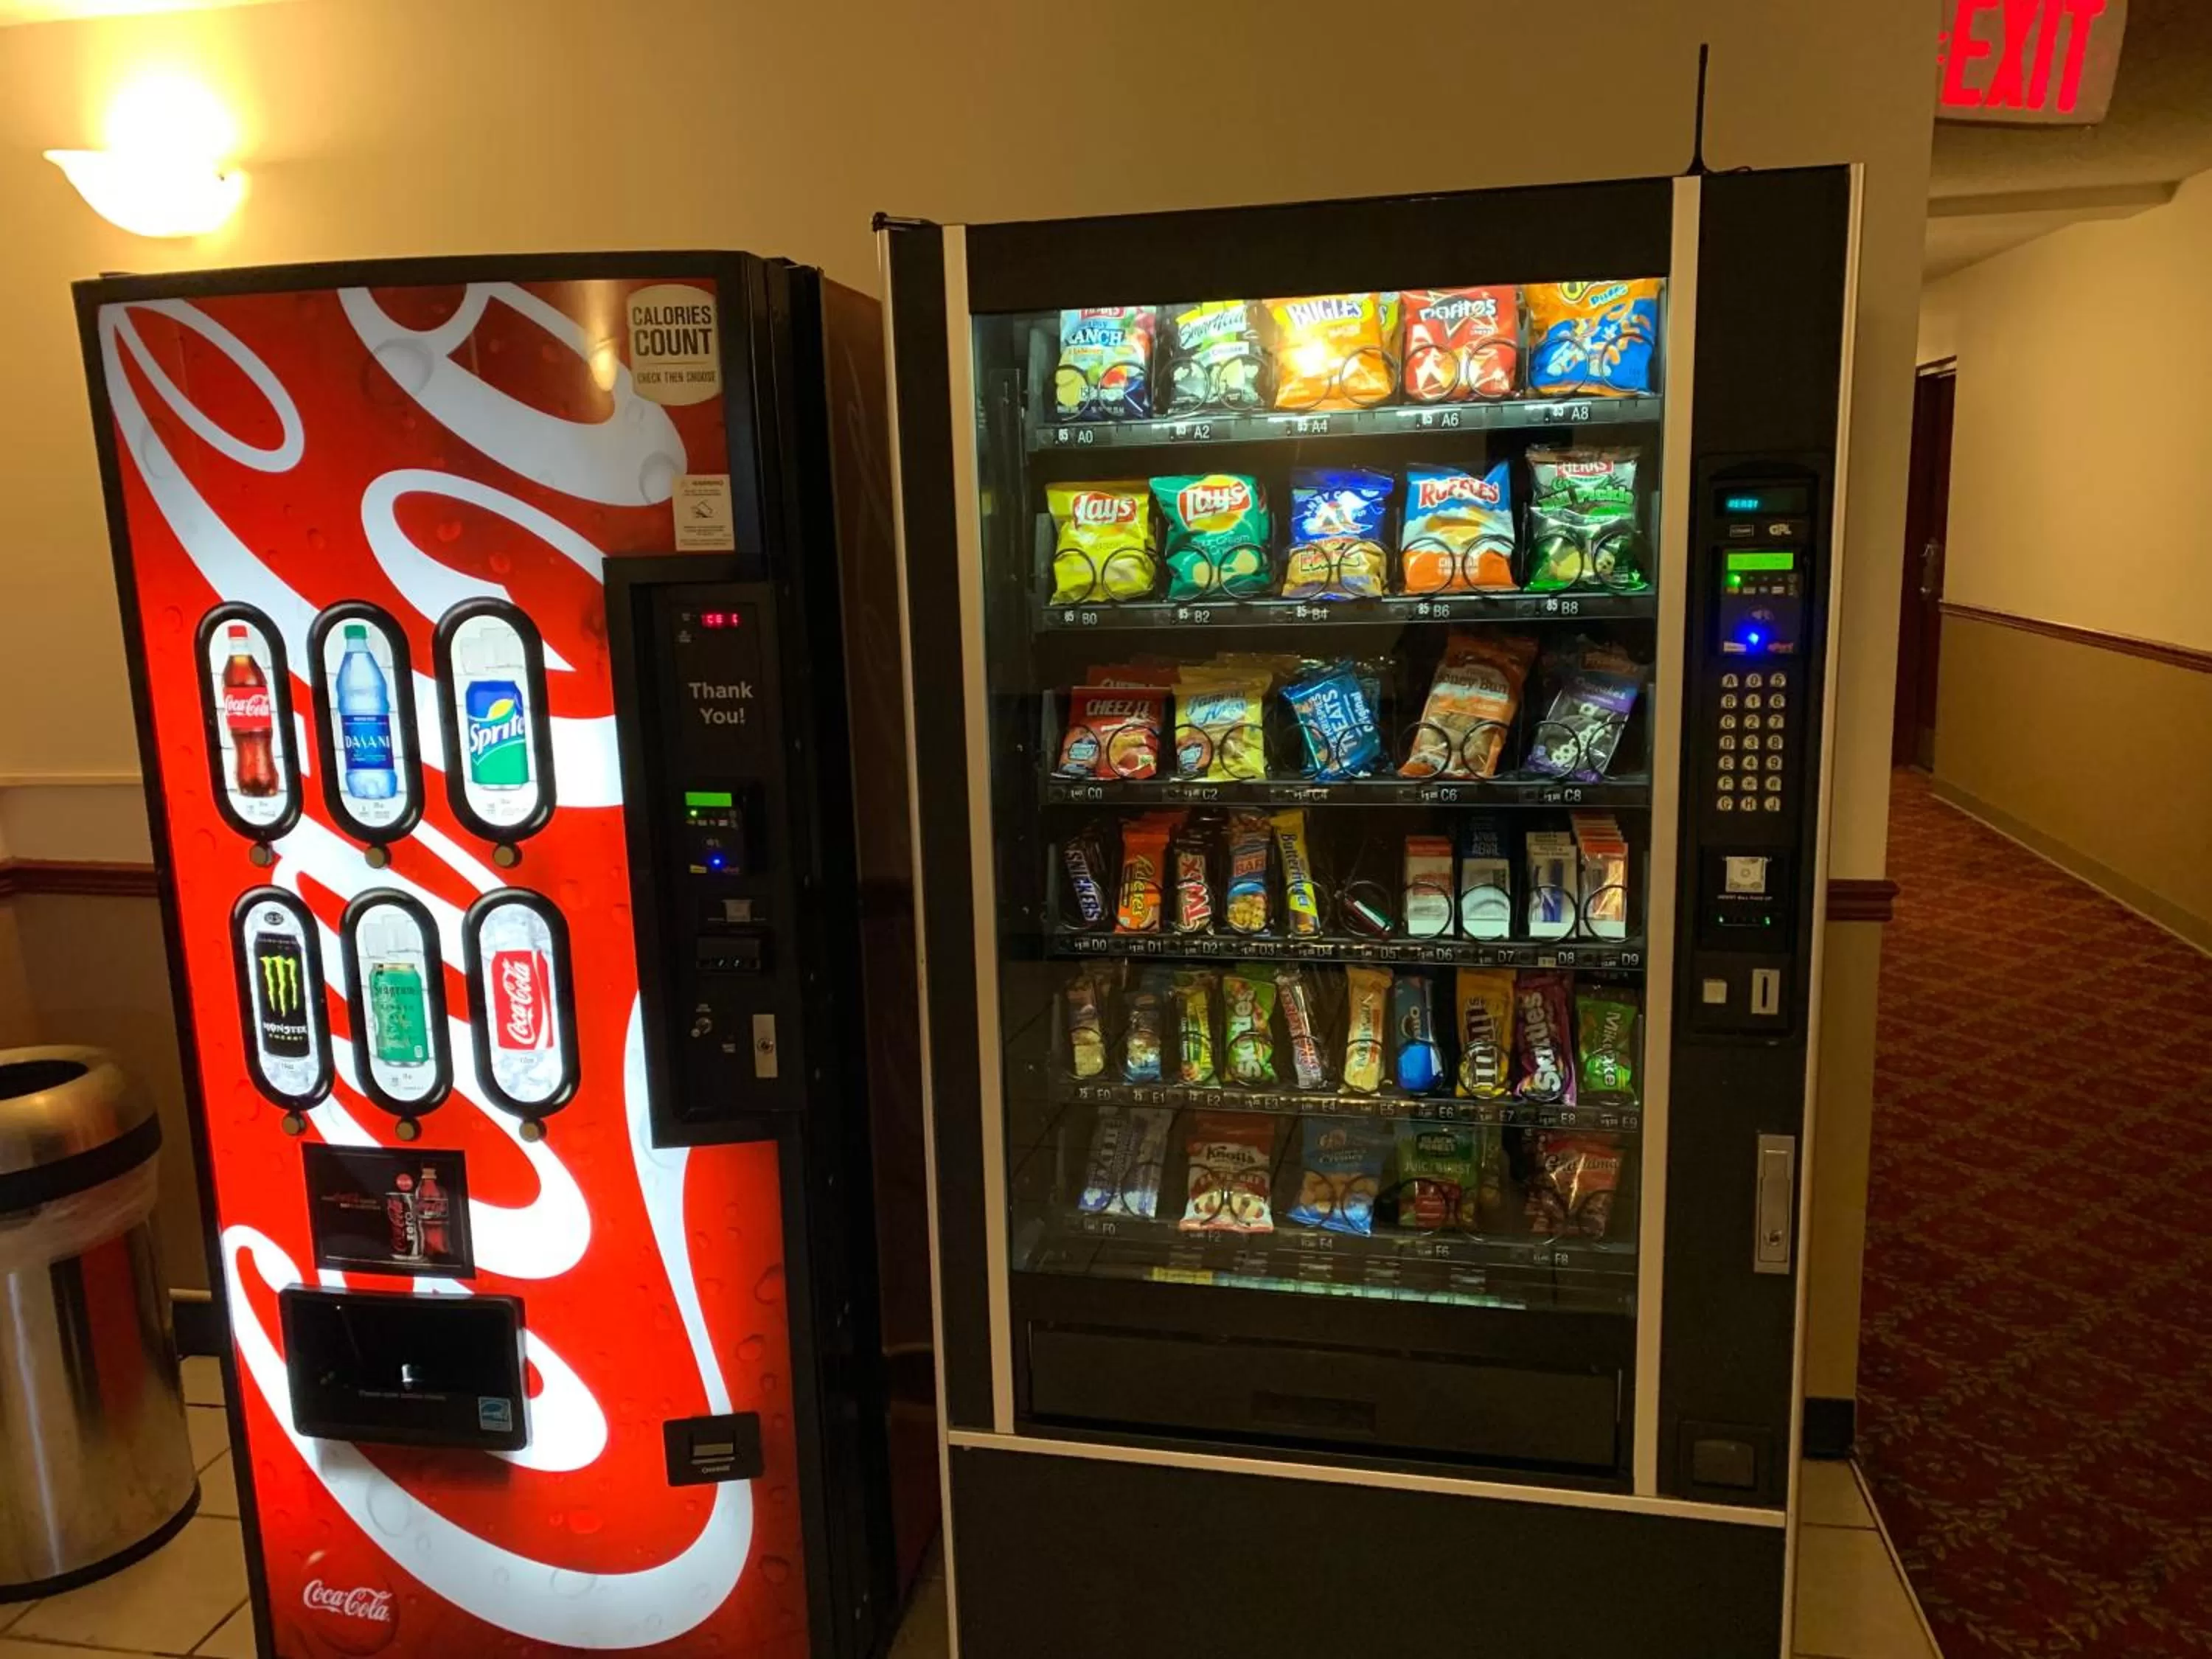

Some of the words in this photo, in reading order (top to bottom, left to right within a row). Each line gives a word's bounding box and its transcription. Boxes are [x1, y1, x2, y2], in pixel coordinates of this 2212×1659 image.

[1941, 0, 2107, 114] EXIT
[633, 306, 712, 326] CALORIES
[635, 328, 712, 356] COUNT
[636, 371, 661, 384] CHECK
[664, 371, 684, 383] THEN
[1571, 406, 1589, 420] A8
[1312, 420, 1328, 433] A4
[1441, 413, 1459, 427] A6
[1077, 430, 1093, 443] A0
[1194, 425, 1210, 439] A2
[1433, 604, 1450, 618] B6
[1561, 601, 1579, 614] B8
[1082, 613, 1098, 625] B0
[1194, 610, 1210, 623] B2
[688, 681, 754, 699] Thank
[225, 695, 270, 717] Coca-Cola
[699, 707, 745, 725] You!
[345, 734, 391, 749] DASANI
[1088, 787, 1102, 799] C0
[1203, 787, 1217, 801] C2
[1441, 788, 1458, 801] C6
[1564, 788, 1582, 802] C8
[1092, 938, 1107, 951] D0
[1147, 940, 1162, 953] D1
[1203, 942, 1217, 954] D2
[1436, 947, 1453, 961] D6
[1498, 950, 1514, 962] D7
[1558, 951, 1575, 964] D8
[1621, 952, 1640, 966] D9
[501, 956, 537, 1046] Coca-Cola
[262, 1022, 308, 1035] MONSTER
[268, 1033, 304, 1041] ENERGY
[1523, 992, 1562, 1093] Skittles
[1207, 1093, 1221, 1106] E2
[1439, 1106, 1454, 1119] E6
[1499, 1109, 1514, 1121] E7
[1561, 1113, 1576, 1125] E8
[1622, 1116, 1638, 1128] E9
[1555, 1252, 1569, 1265] F8
[303, 1579, 393, 1622] Coca-Cola
